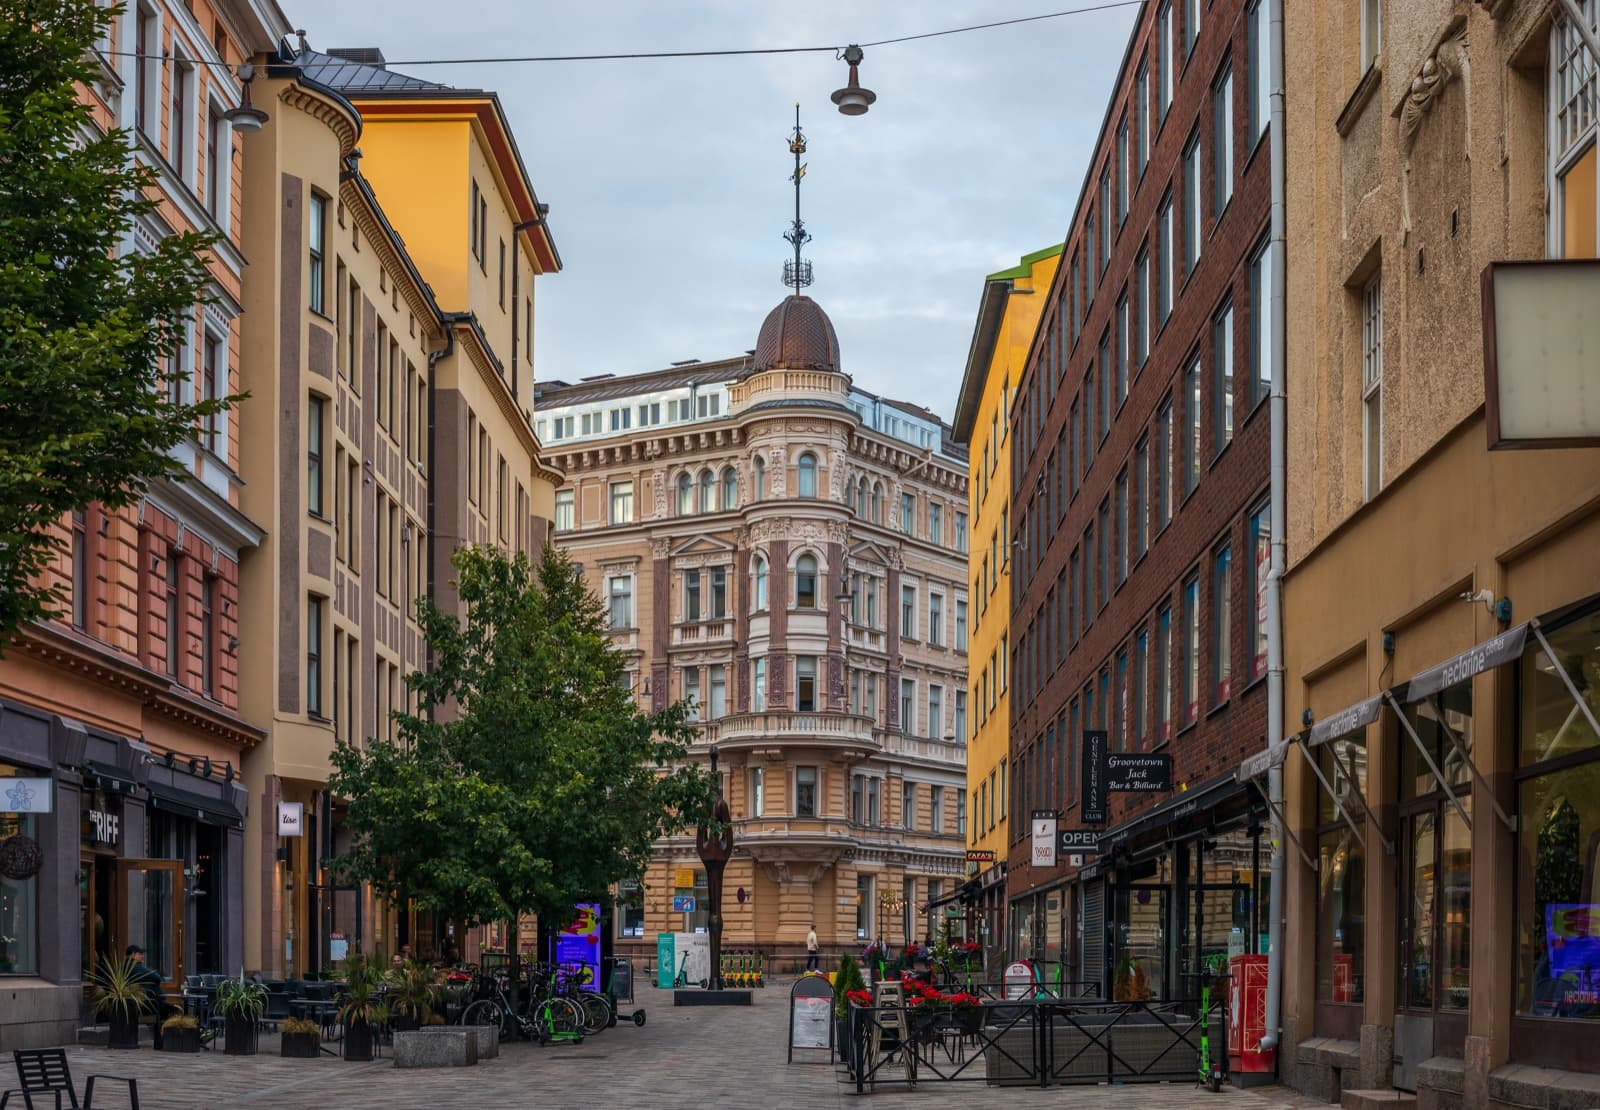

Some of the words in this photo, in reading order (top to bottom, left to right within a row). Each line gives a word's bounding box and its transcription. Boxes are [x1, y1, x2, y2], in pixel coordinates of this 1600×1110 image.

[1441, 651, 1485, 688] nectarine
[1330, 708, 1358, 737] nectarine
[1090, 736, 1099, 809] GENTLEMANS
[1108, 756, 1163, 768] Groovetown
[1125, 768, 1148, 780] Jack
[1108, 781, 1123, 789] Bar
[1132, 781, 1163, 789] Billiard
[96, 811, 119, 844] RIFF
